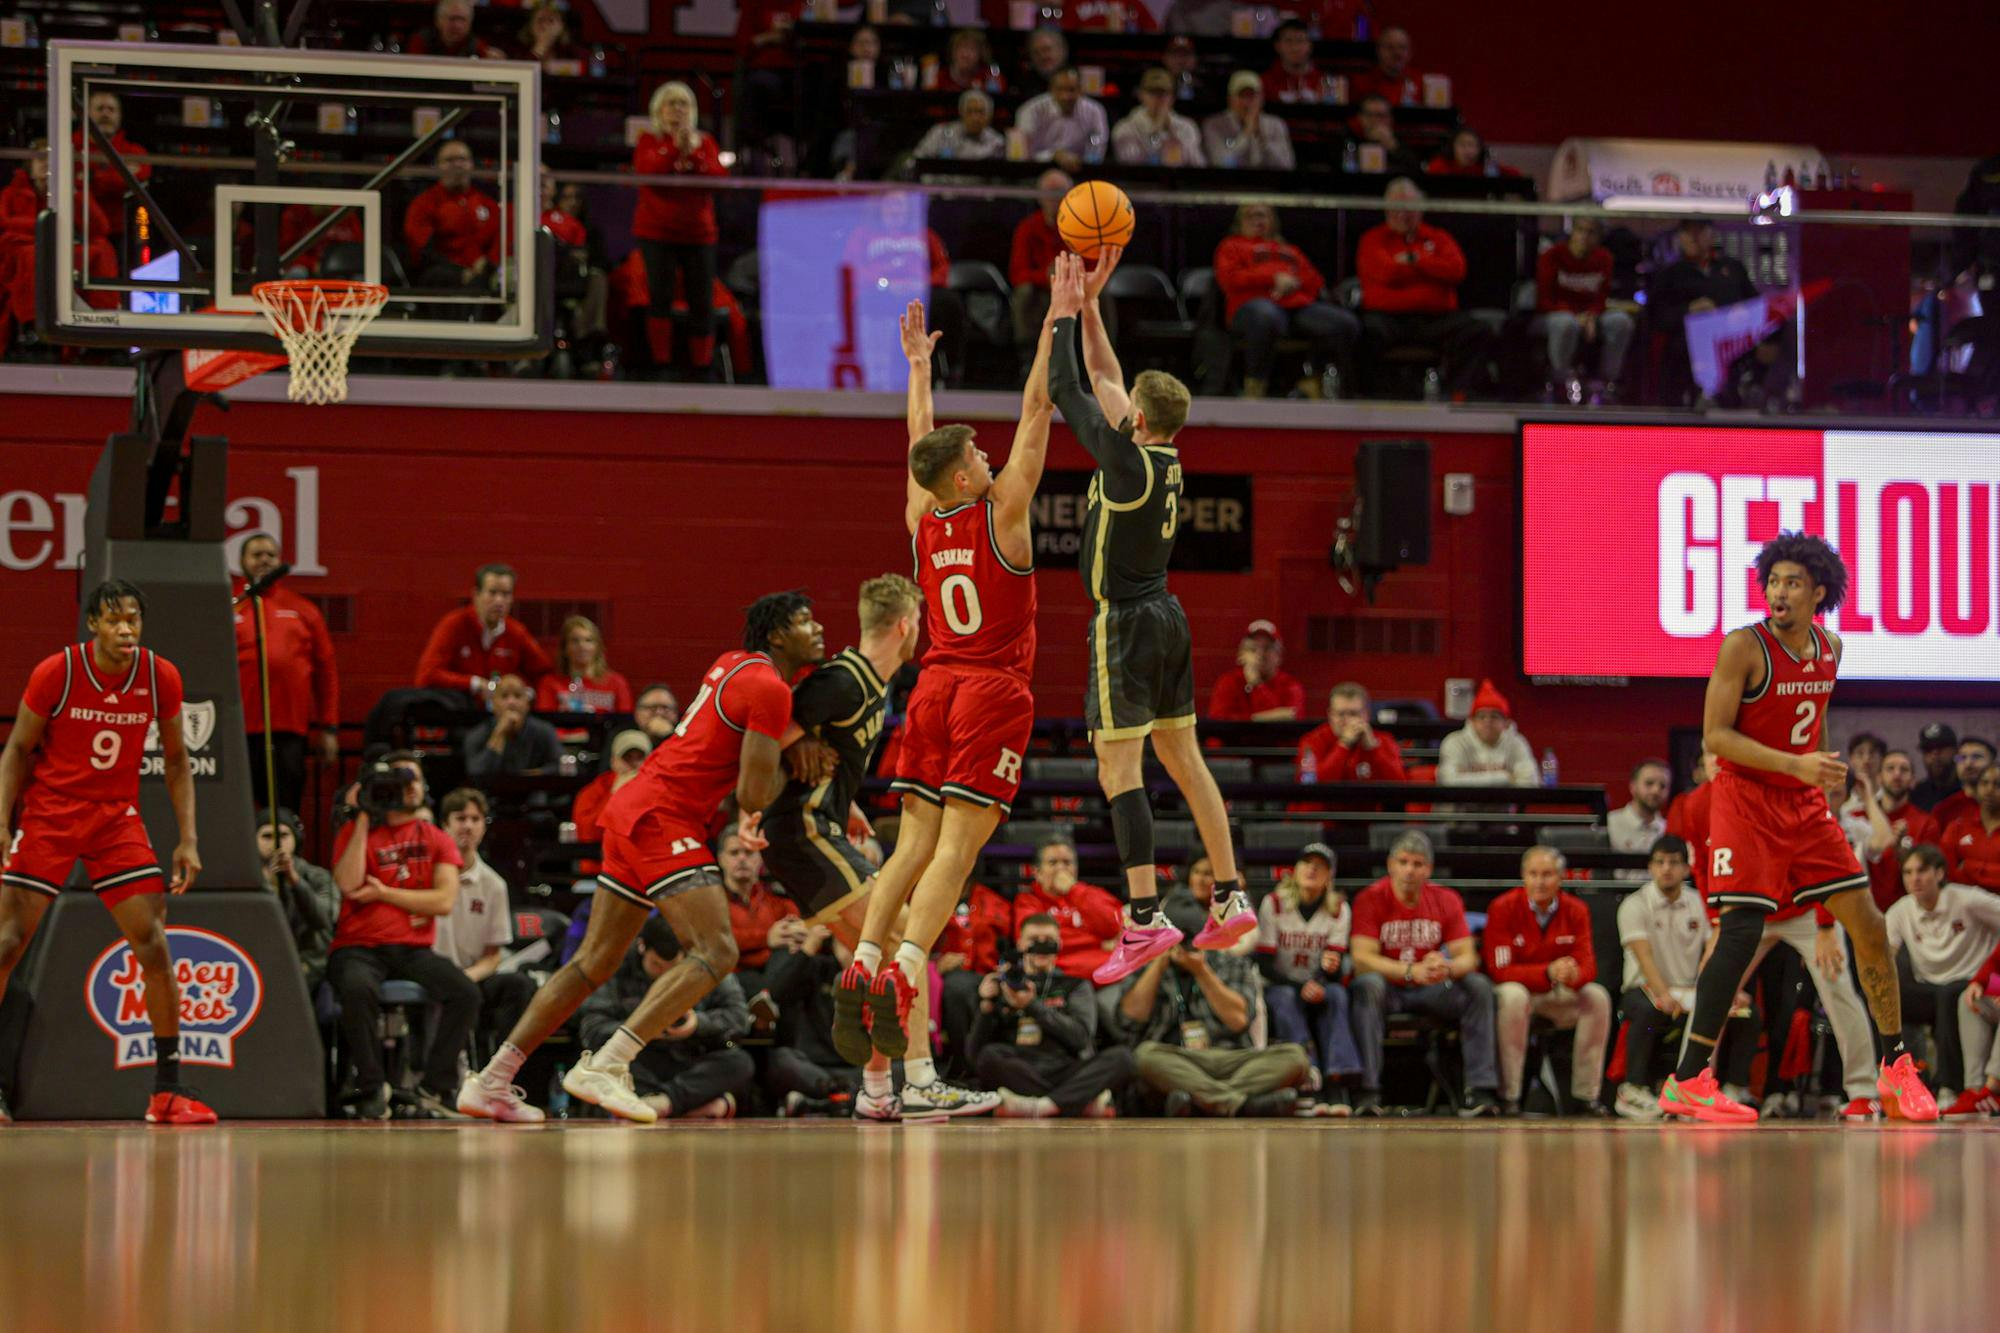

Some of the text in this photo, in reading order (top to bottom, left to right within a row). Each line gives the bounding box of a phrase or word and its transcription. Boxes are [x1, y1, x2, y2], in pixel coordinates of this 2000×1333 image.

[1161, 491, 1177, 539] 3
[930, 548, 975, 570] DERKACK
[1658, 472, 1817, 637] GET
[940, 574, 983, 636] 0
[1776, 680, 1835, 696] RUTGERS
[69, 706, 149, 726] RUTGERS
[1790, 699, 1817, 746] 2
[89, 729, 122, 771] 9
[992, 747, 1022, 785] R
[1712, 847, 1735, 878] R
[514, 911, 544, 937] R
